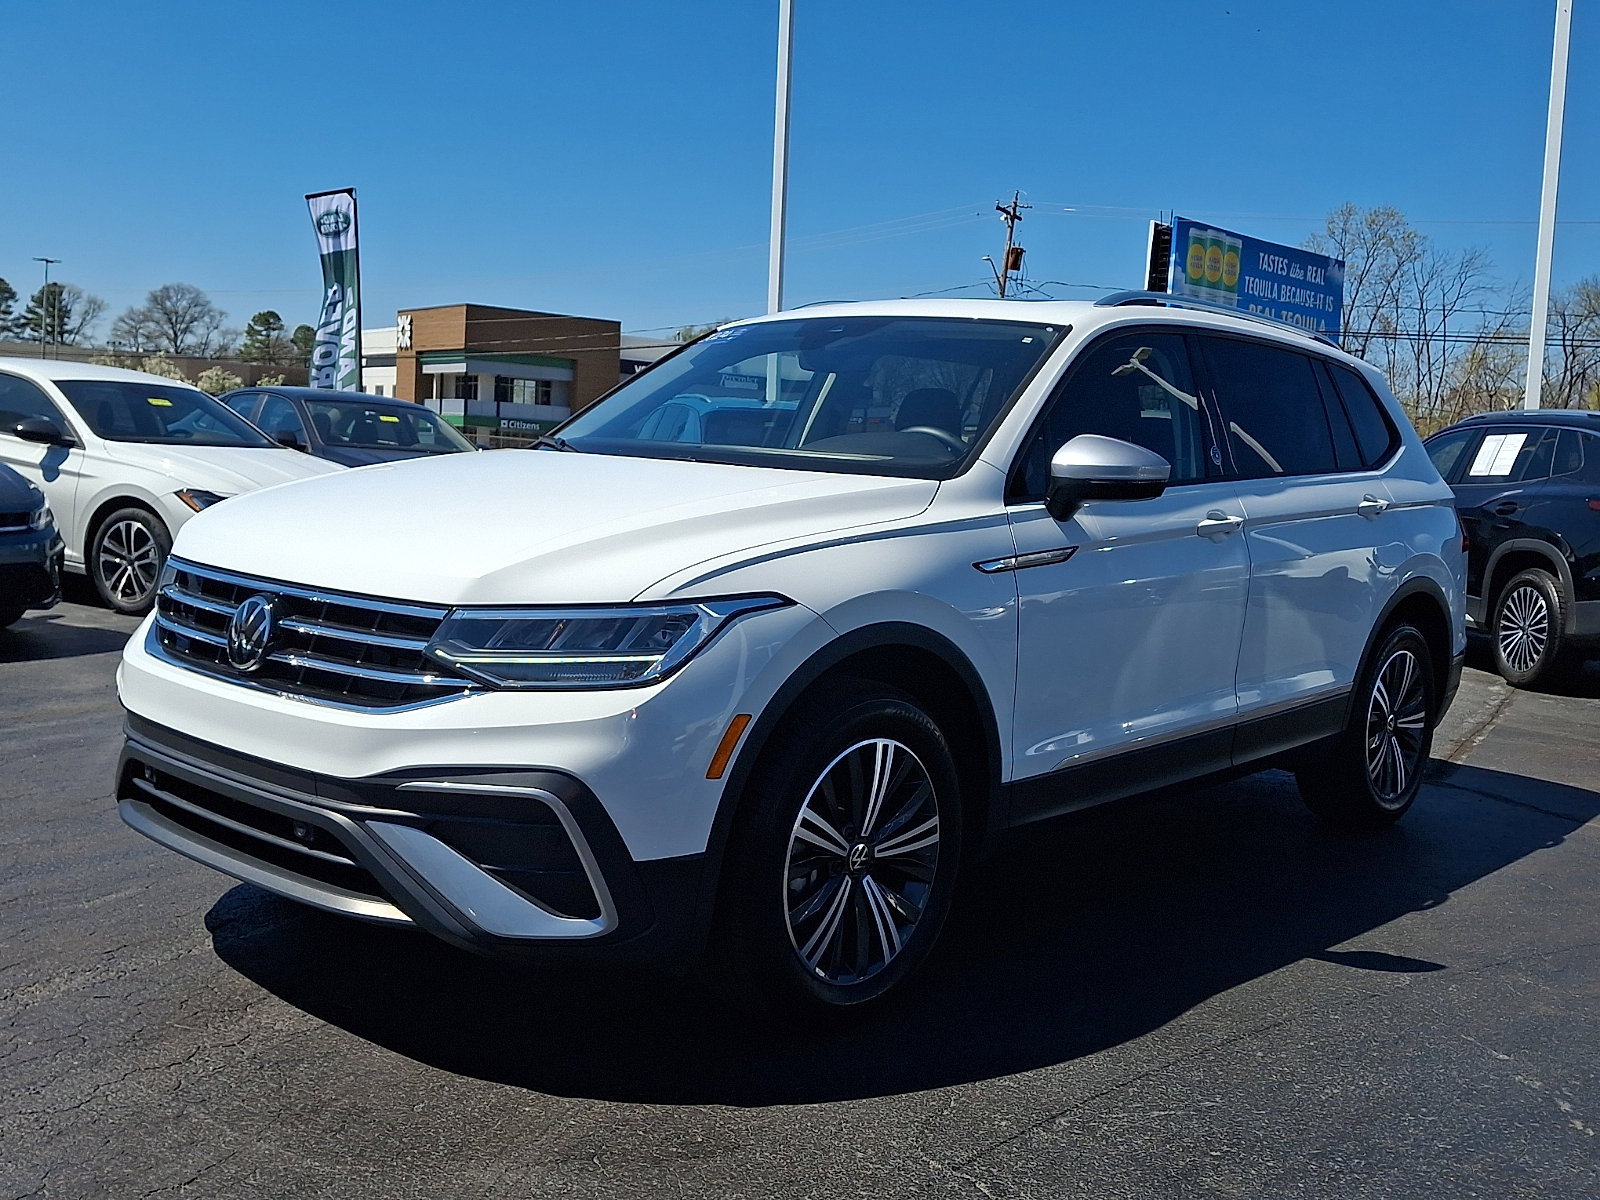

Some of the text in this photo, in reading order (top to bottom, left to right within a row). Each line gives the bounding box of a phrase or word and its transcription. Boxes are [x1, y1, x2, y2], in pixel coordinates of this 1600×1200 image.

[1259, 252, 1289, 276] TASTES
[1289, 262, 1305, 280] like
[1306, 265, 1325, 286] REAL
[1244, 275, 1334, 313] TEQUILA BECAUSE IT IS
[509, 420, 540, 430] Citizens
